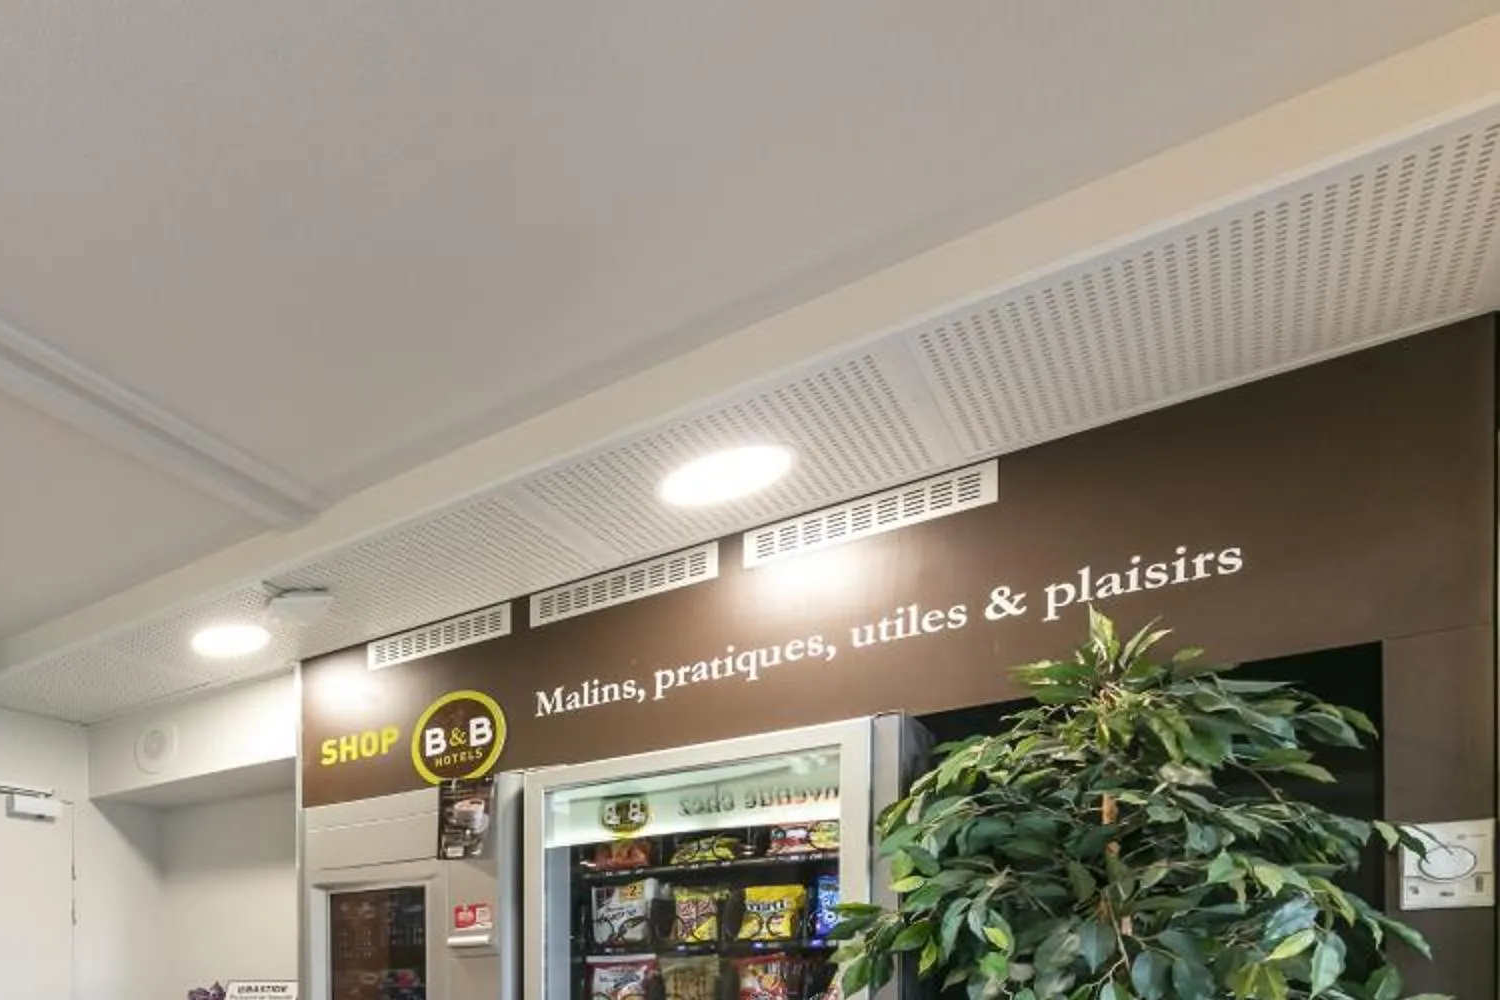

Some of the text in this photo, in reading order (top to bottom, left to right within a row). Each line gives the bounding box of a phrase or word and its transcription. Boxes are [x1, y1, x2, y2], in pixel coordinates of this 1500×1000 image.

[535, 545, 1244, 717] Malins, pratiques, utiles & plaisirs
[320, 725, 399, 766] SHOP
[425, 715, 494, 758] B&B
[434, 748, 484, 767] HOTELS
